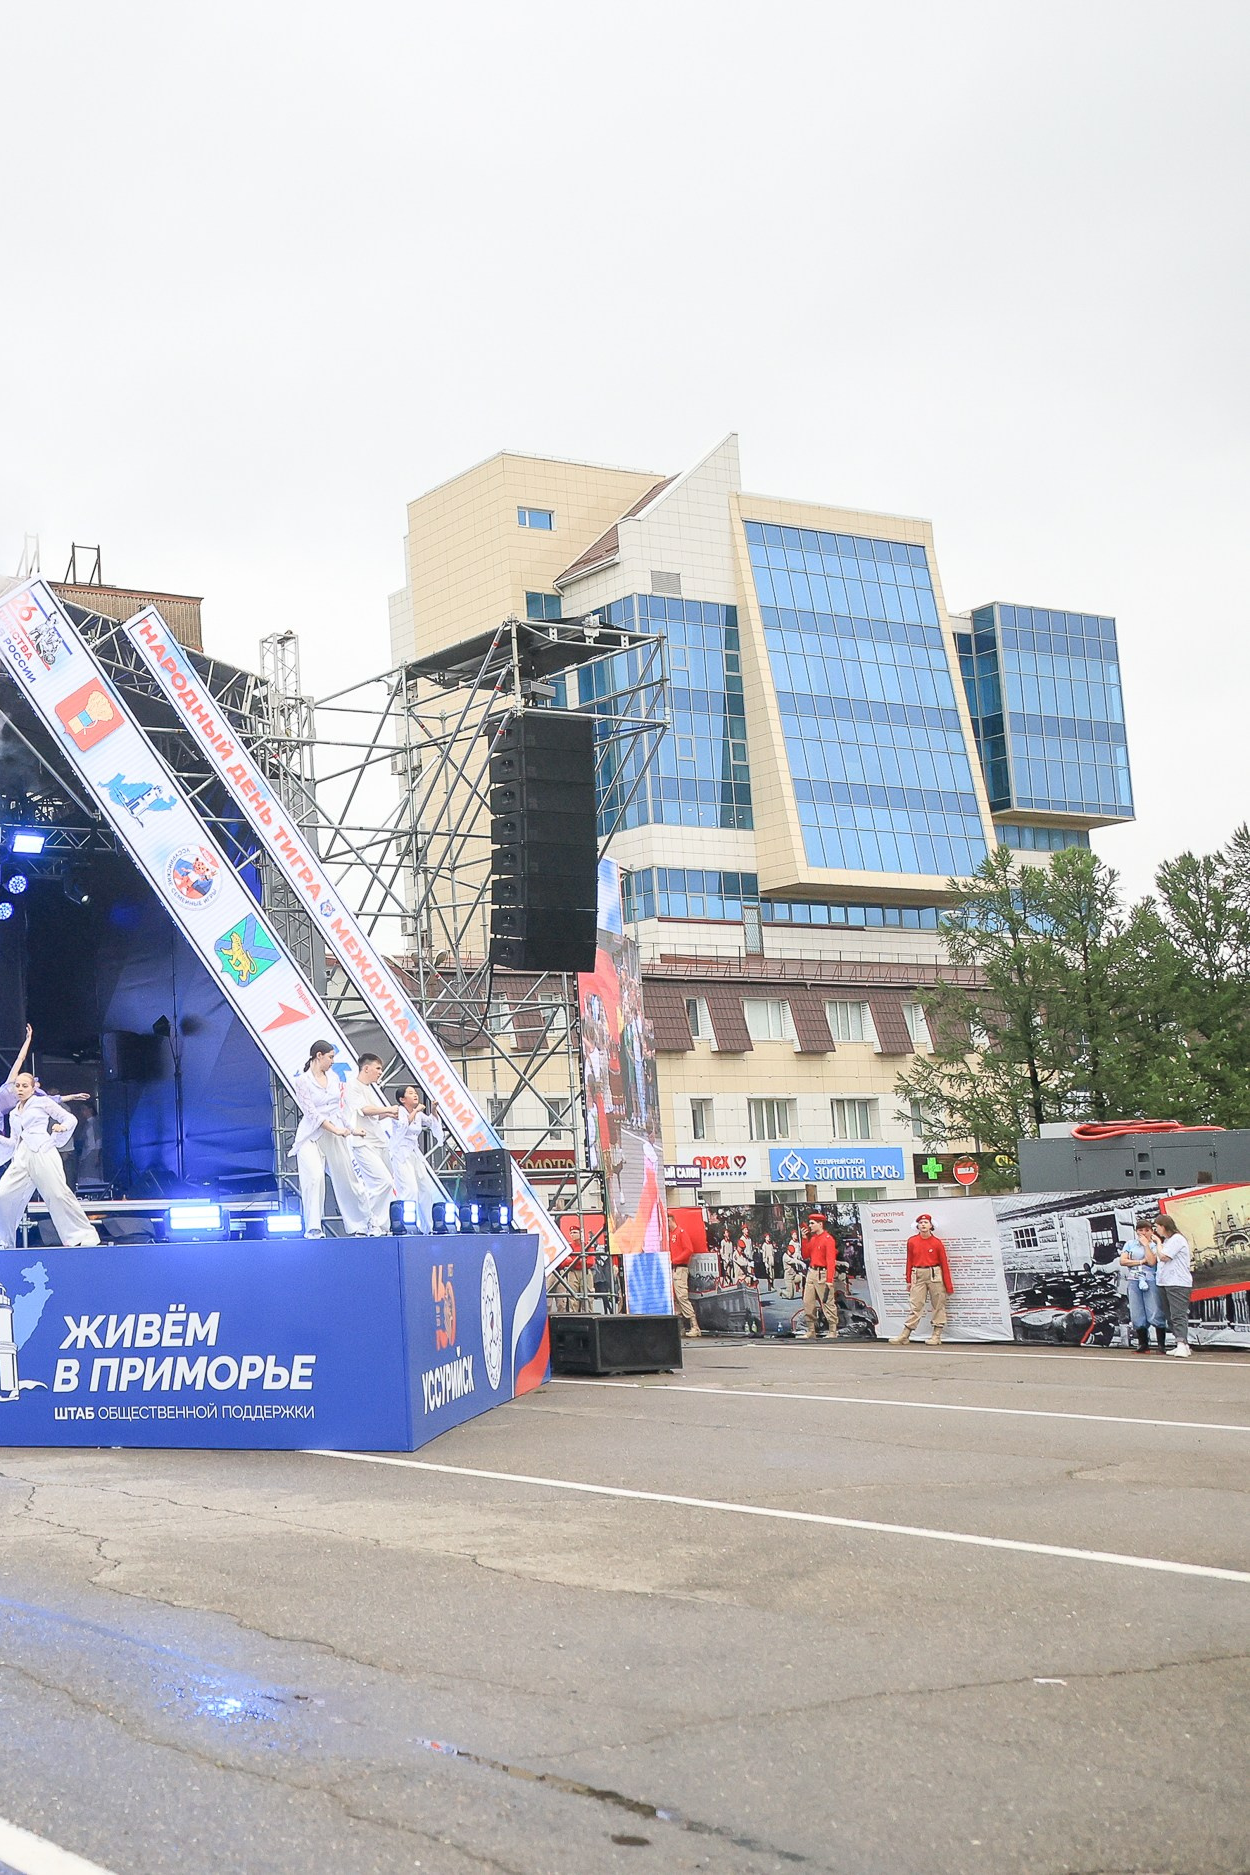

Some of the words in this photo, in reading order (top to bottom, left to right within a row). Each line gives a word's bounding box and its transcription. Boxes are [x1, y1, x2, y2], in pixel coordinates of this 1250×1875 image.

[3, 638, 36, 683] РОССИИ
[139, 619, 234, 761] НАРОДНЫЙ
[226, 763, 272, 826] ДЕНЬ
[273, 825, 321, 901] ТИГРА
[330, 917, 475, 1131] МЕЖДУНАРОДНЫЙ
[294, 983, 316, 1015] Первые
[675, 1167, 700, 1178] САЛОН
[815, 1165, 867, 1180] ЗОЛОТАЯ
[871, 1165, 901, 1180] РУСЬ
[59, 1303, 221, 1350] ЖИВЁМ
[53, 1358, 81, 1393] В
[89, 1355, 317, 1392] ПРИМОРЬЕ
[421, 1346, 475, 1415] УССУРИЙСК
[54, 1406, 95, 1420] ШТАБ
[97, 1402, 219, 1422] ОБЩЕСТВЕННОЙ
[221, 1405, 315, 1422] ПОДДЕРЖКИ
